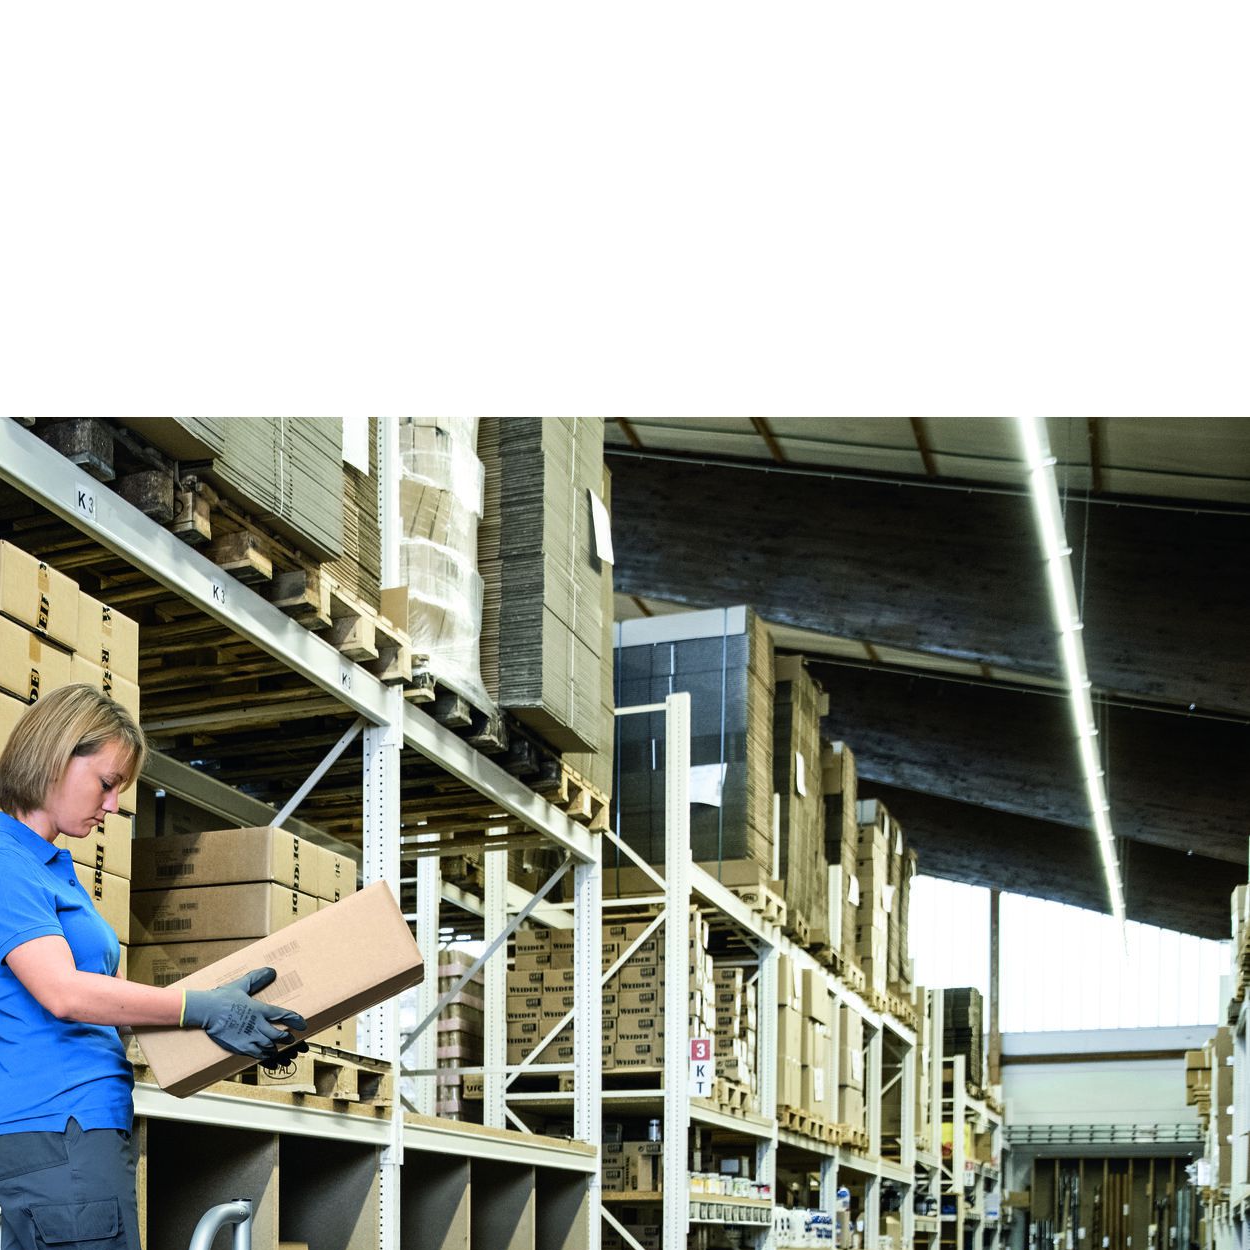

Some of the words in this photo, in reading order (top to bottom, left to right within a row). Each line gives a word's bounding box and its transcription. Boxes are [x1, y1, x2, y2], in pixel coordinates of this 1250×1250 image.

[78, 490, 86, 510] K
[89, 496, 94, 514] 3
[213, 584, 220, 601] K
[696, 1042, 706, 1058] 3
[696, 1064, 705, 1078] K
[696, 1081, 705, 1094] T
